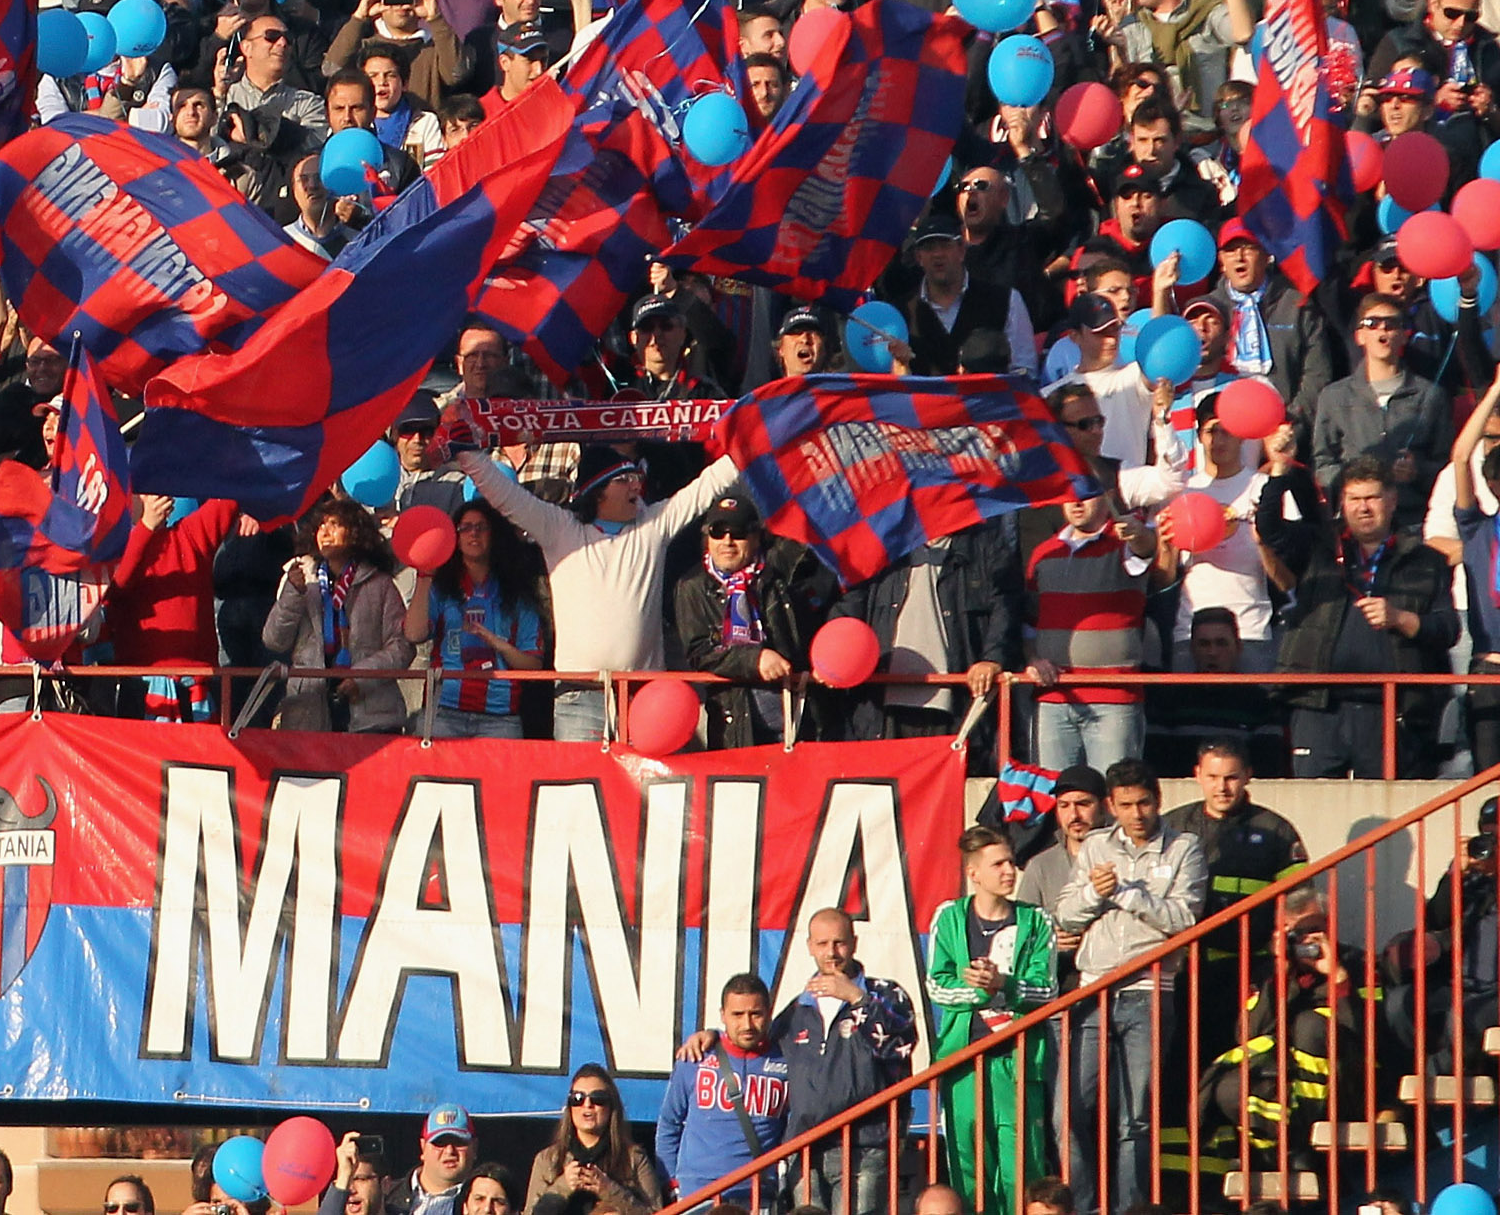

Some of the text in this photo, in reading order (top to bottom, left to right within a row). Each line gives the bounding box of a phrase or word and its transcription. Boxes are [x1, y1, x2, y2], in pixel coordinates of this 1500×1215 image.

[487, 405, 721, 431] FORZA CATANIA
[139, 762, 934, 1080] MANIA
[696, 1068, 790, 1118] BOND
